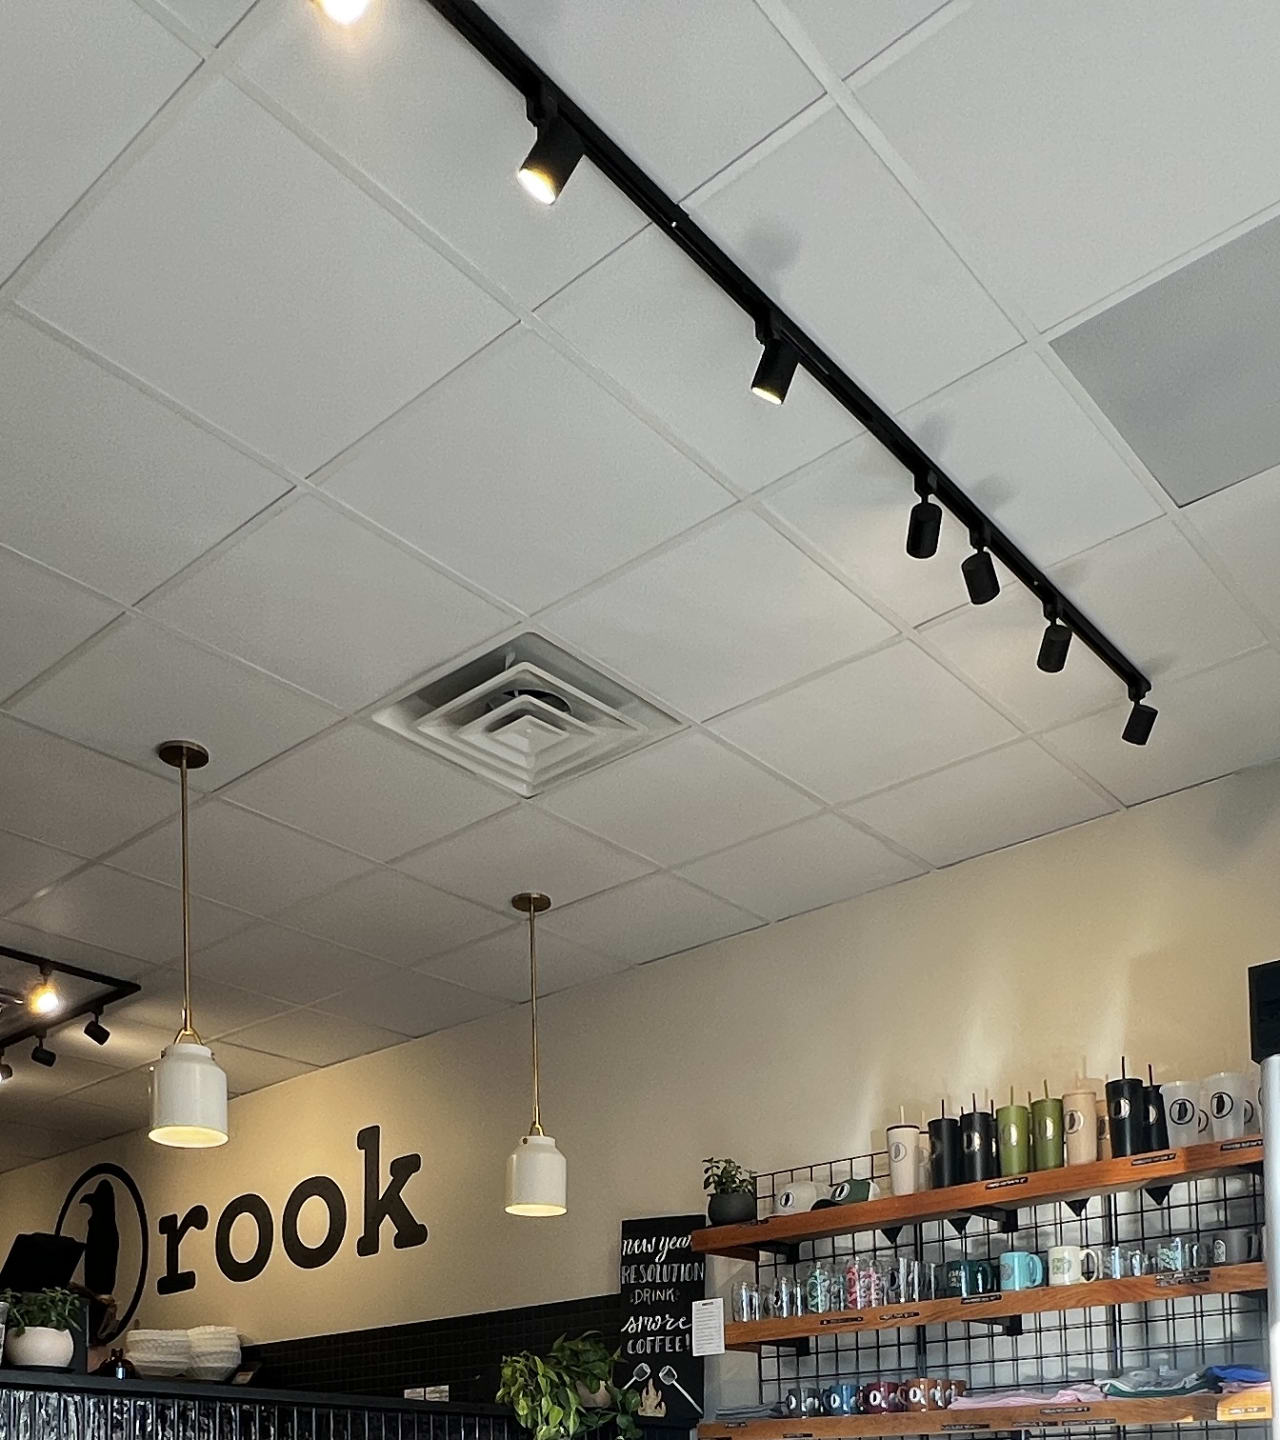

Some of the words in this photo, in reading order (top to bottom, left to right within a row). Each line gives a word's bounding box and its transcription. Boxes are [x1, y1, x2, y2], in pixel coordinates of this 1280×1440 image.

[157, 1124, 428, 1296] rook
[622, 1262, 705, 1284] RESOLUTION
[633, 1288, 676, 1305] DRINK
[626, 1333, 691, 1355] COFFEE!
